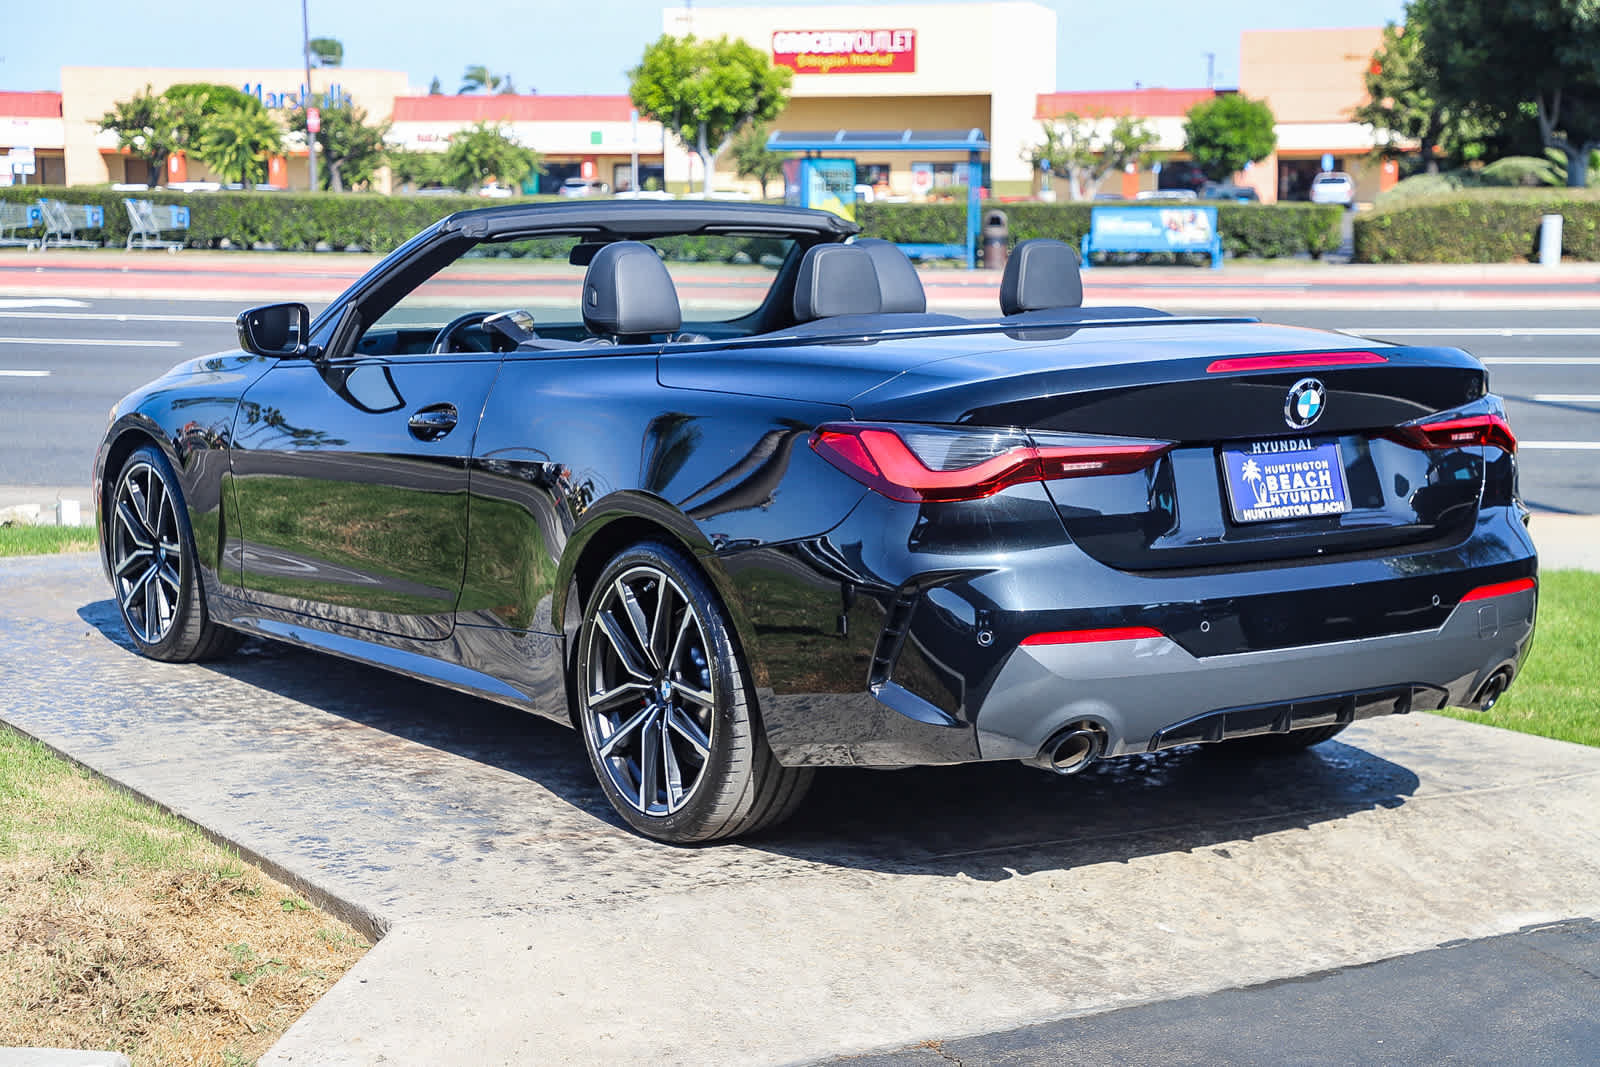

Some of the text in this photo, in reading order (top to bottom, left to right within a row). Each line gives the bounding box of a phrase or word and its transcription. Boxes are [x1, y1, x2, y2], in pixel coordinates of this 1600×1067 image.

[1252, 438, 1312, 454] HYUNDAI
[1264, 460, 1329, 474] HUNTINGTON
[1265, 470, 1331, 491] BEACH
[1269, 489, 1335, 506] HYUNDAI
[1243, 501, 1345, 521] HUNTINGTON BEACH
